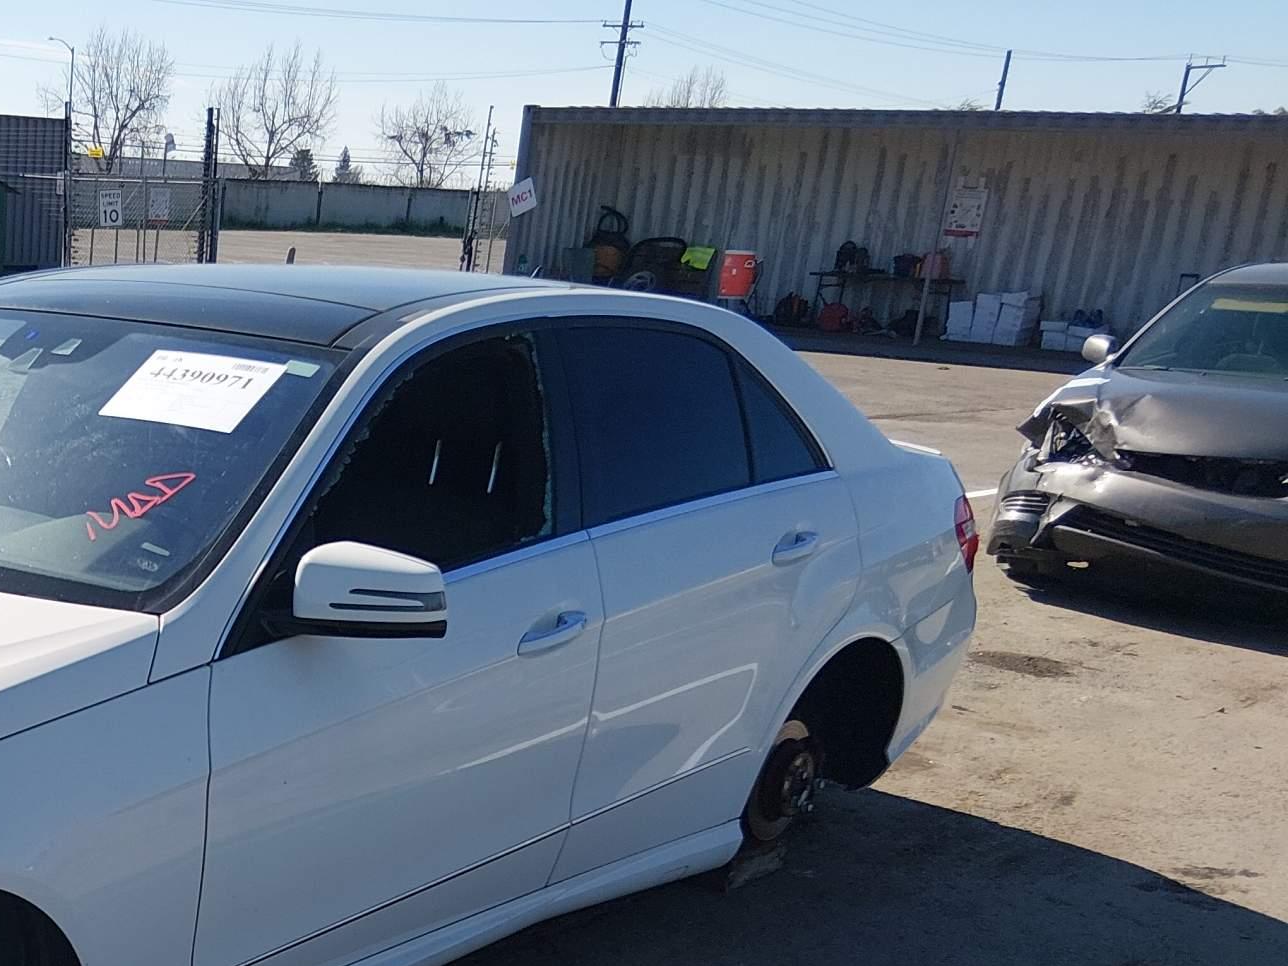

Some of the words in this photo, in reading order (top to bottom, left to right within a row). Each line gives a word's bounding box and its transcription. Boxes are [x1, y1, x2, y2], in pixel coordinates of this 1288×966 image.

[511, 188, 533, 207] MC1
[103, 209, 119, 223] 10
[149, 366, 255, 390] 44390971
